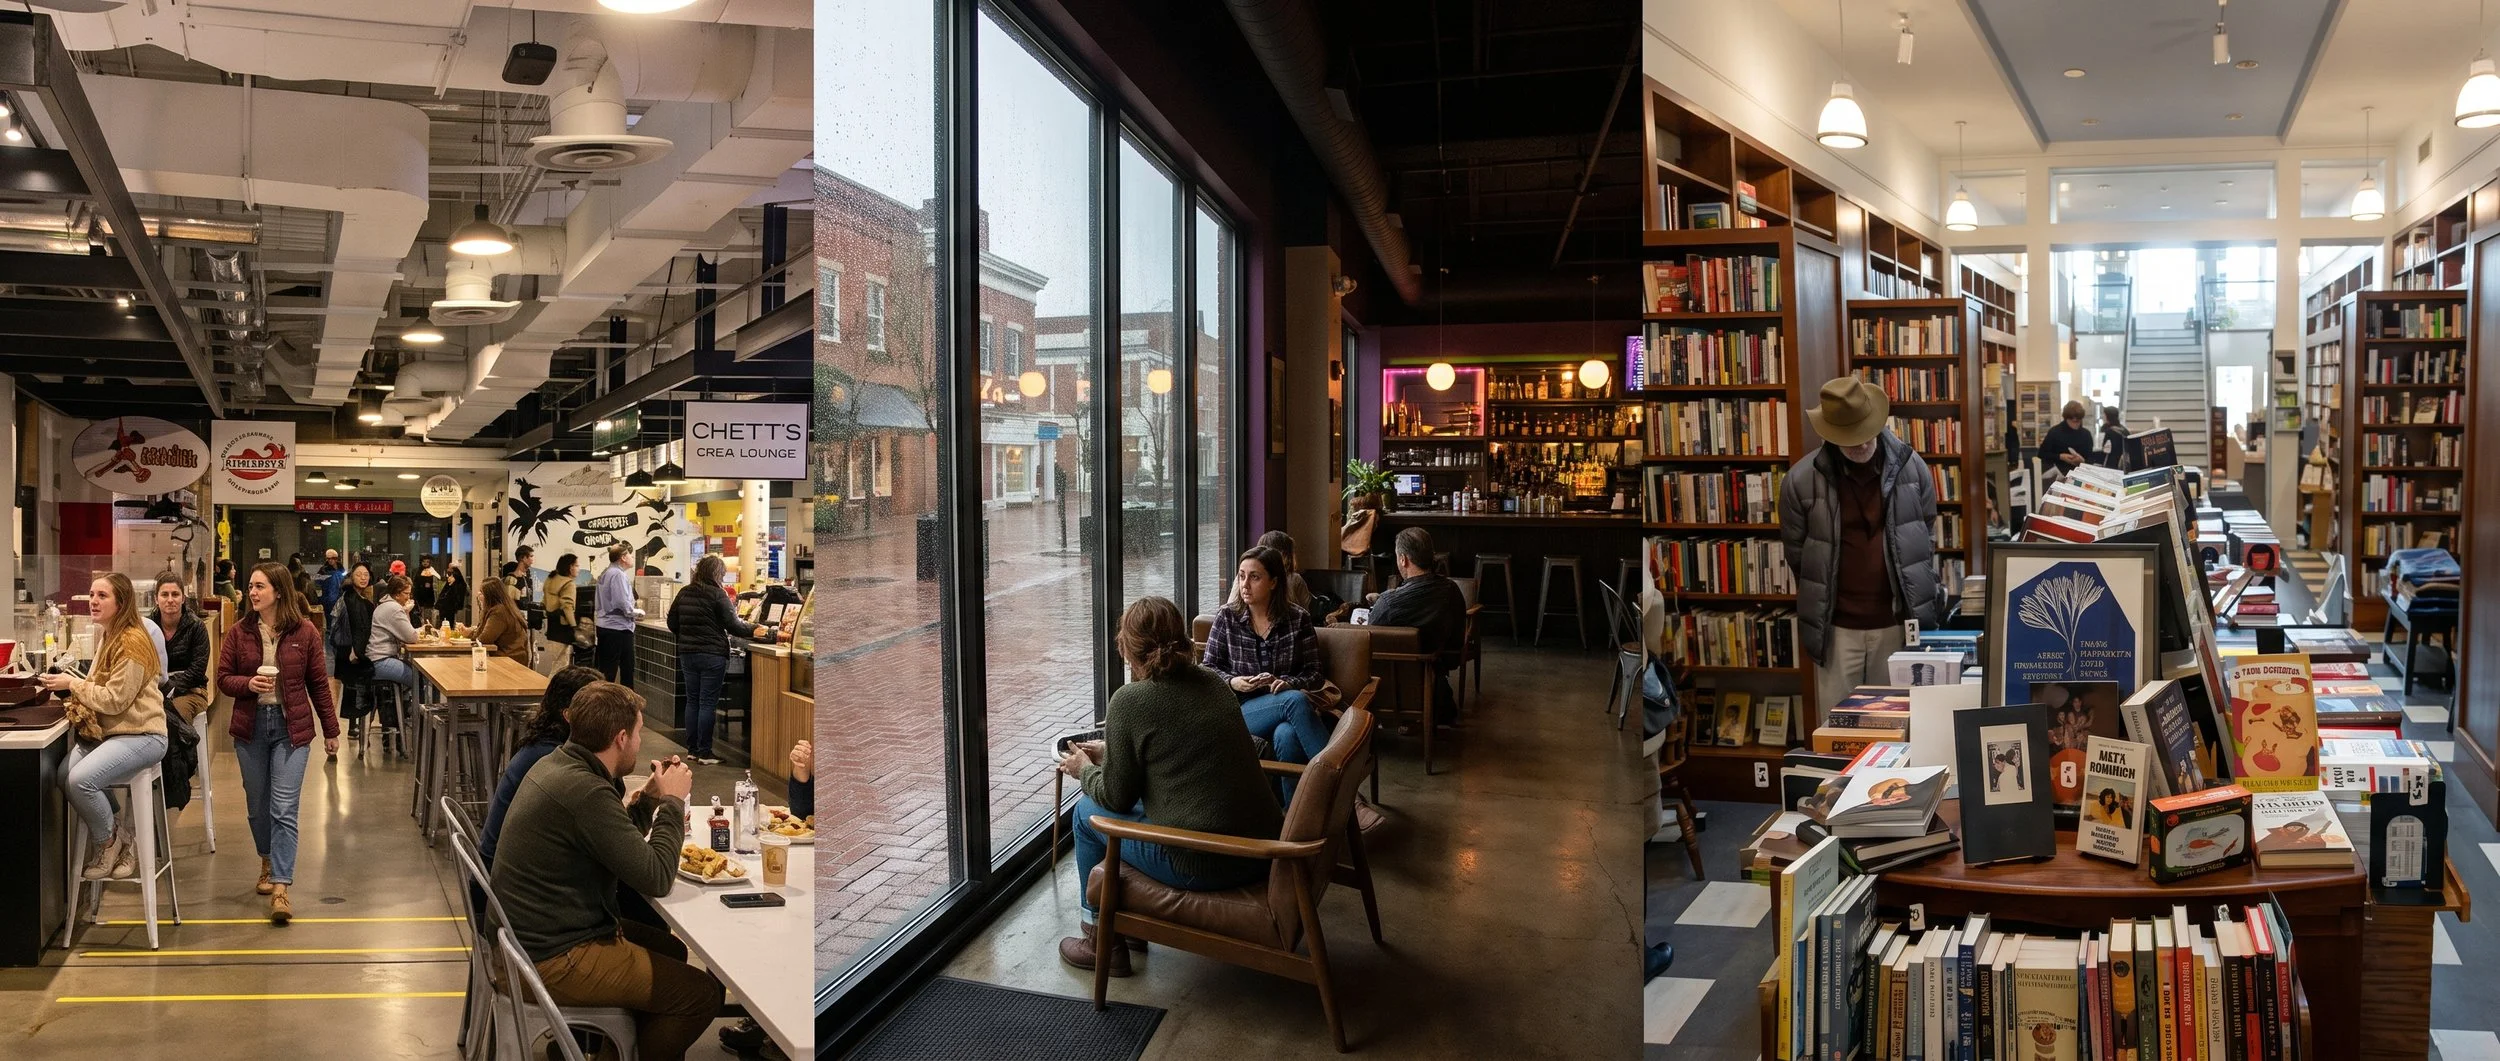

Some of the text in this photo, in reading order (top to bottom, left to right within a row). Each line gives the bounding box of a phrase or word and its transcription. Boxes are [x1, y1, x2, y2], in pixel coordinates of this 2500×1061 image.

[692, 422, 801, 441] CHETT'S
[696, 447, 796, 459] CREA LOUNGE
